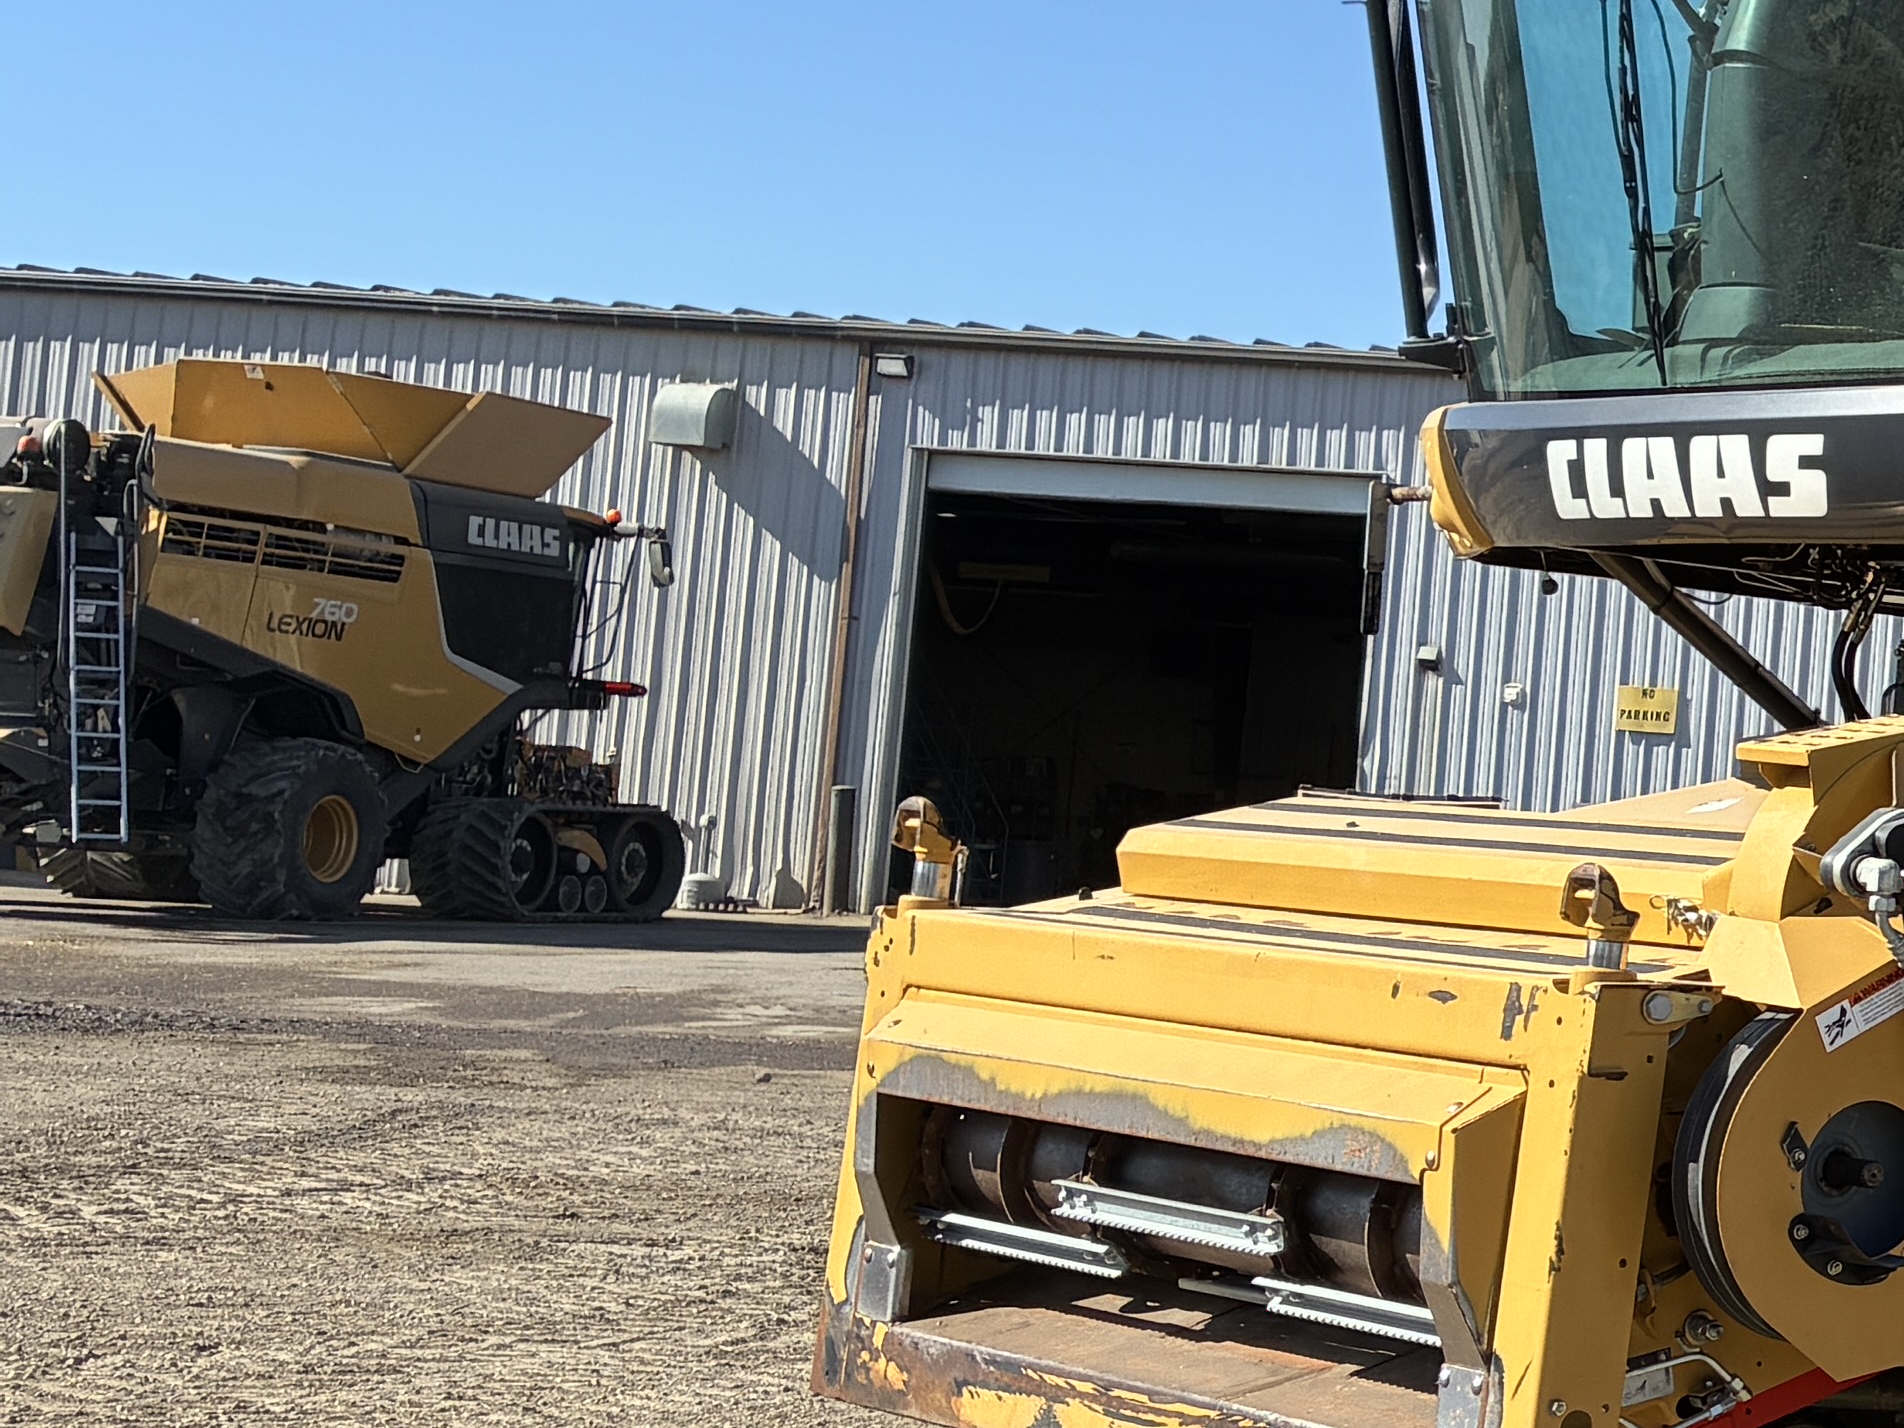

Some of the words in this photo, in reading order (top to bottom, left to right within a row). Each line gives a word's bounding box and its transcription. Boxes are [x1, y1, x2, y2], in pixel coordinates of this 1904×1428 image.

[1546, 433, 1828, 520] CLAAS
[467, 515, 560, 557] CLAAS
[309, 597, 358, 623] 760
[266, 611, 346, 642] LEXION
[1641, 688, 1656, 700] NO
[1619, 709, 1671, 722] PARKING
